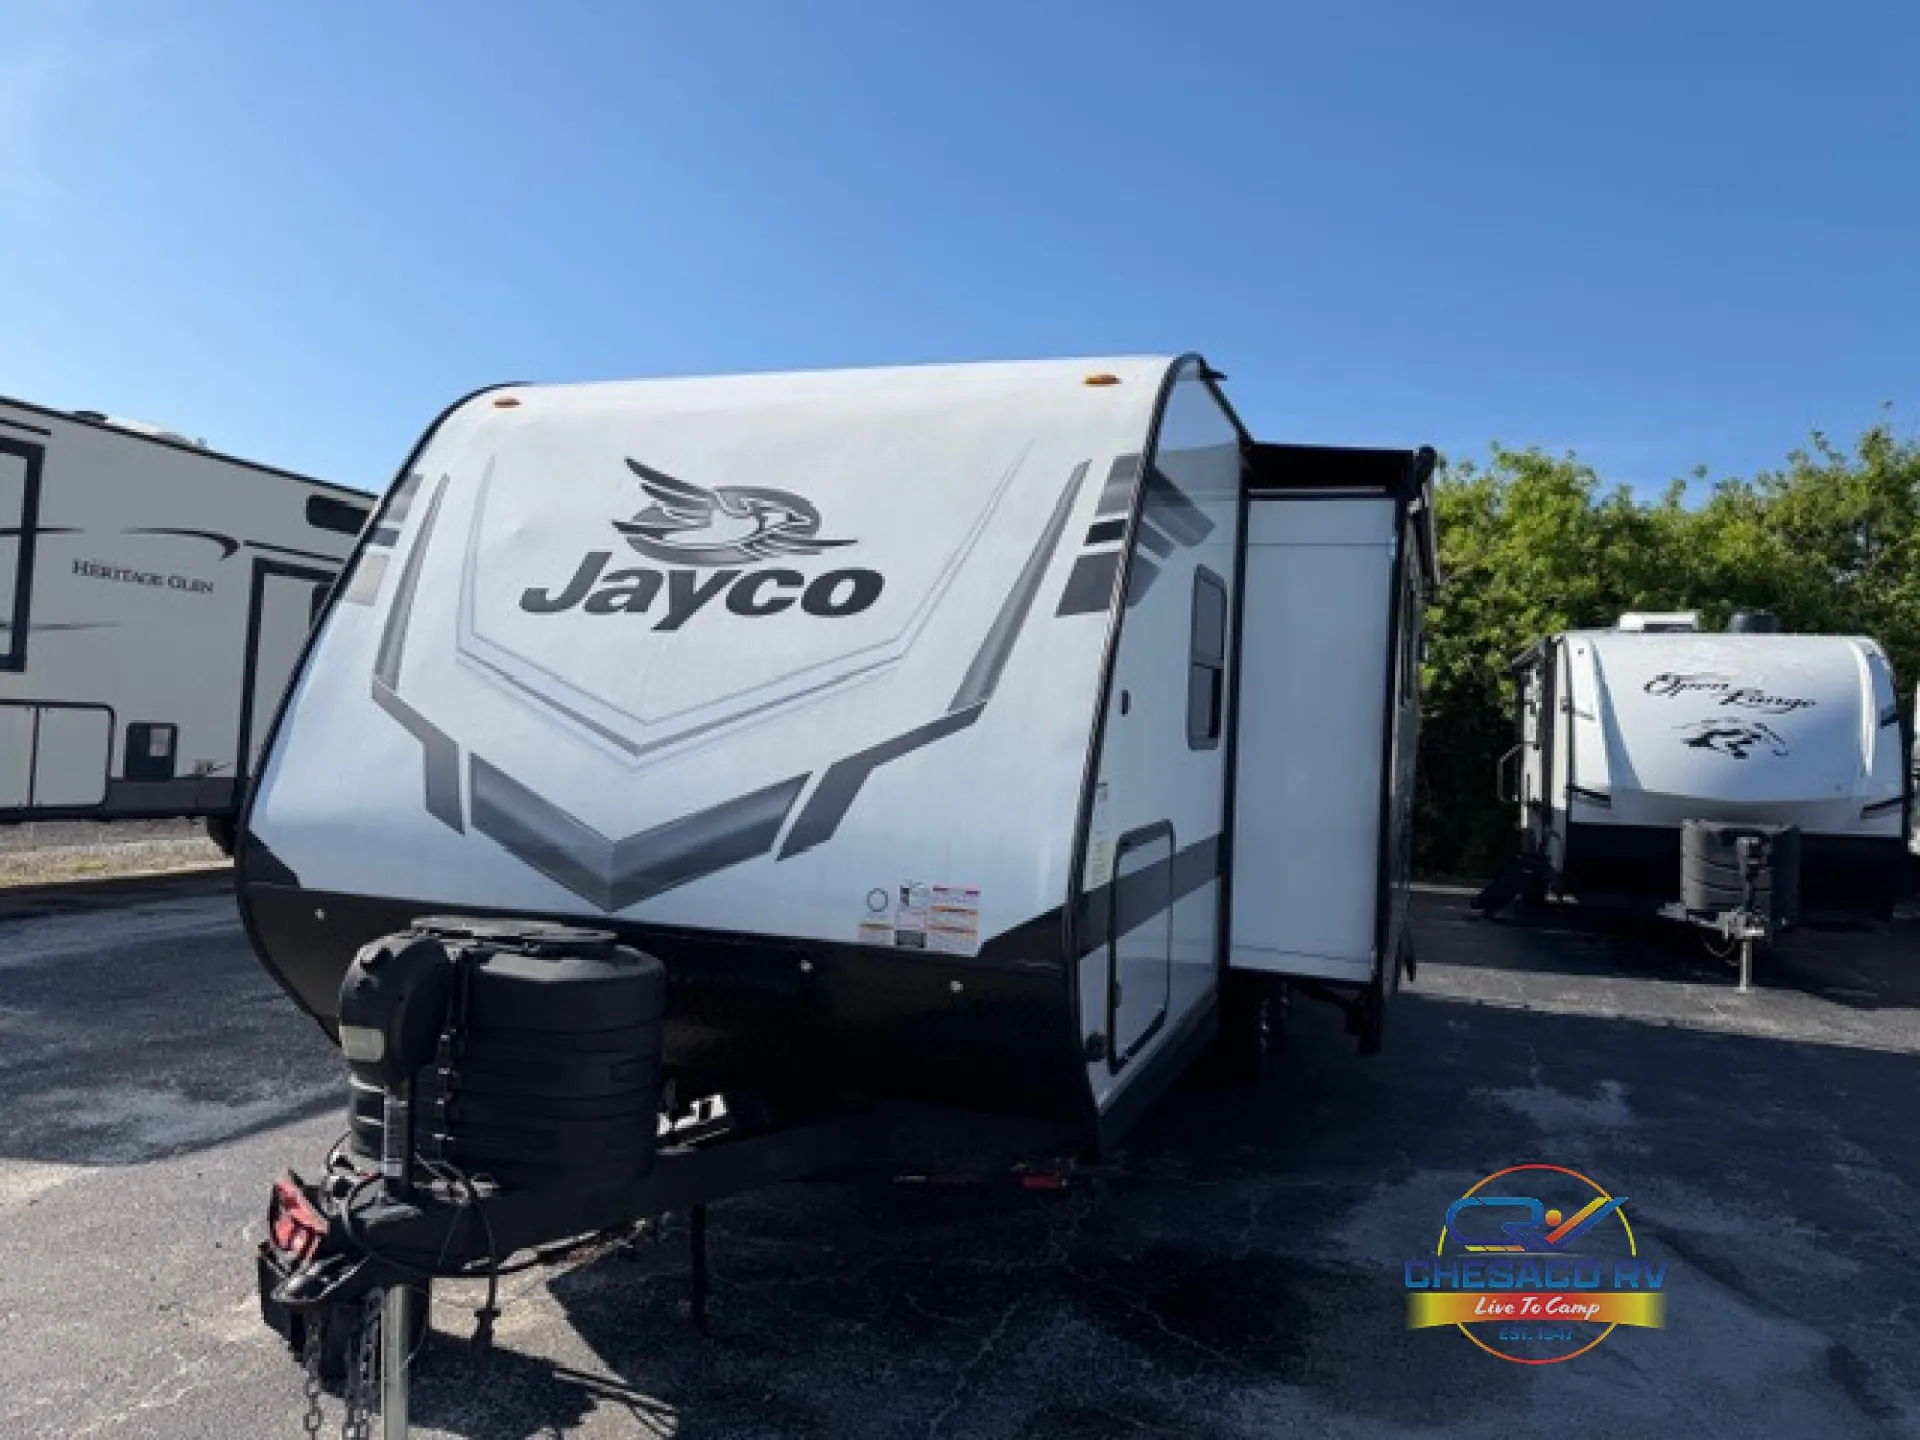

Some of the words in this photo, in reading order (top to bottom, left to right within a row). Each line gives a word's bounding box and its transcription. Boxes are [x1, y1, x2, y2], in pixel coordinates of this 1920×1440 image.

[72, 559, 163, 586] HERITAGE
[167, 574, 214, 594] GLEN
[518, 551, 885, 632] Jayco
